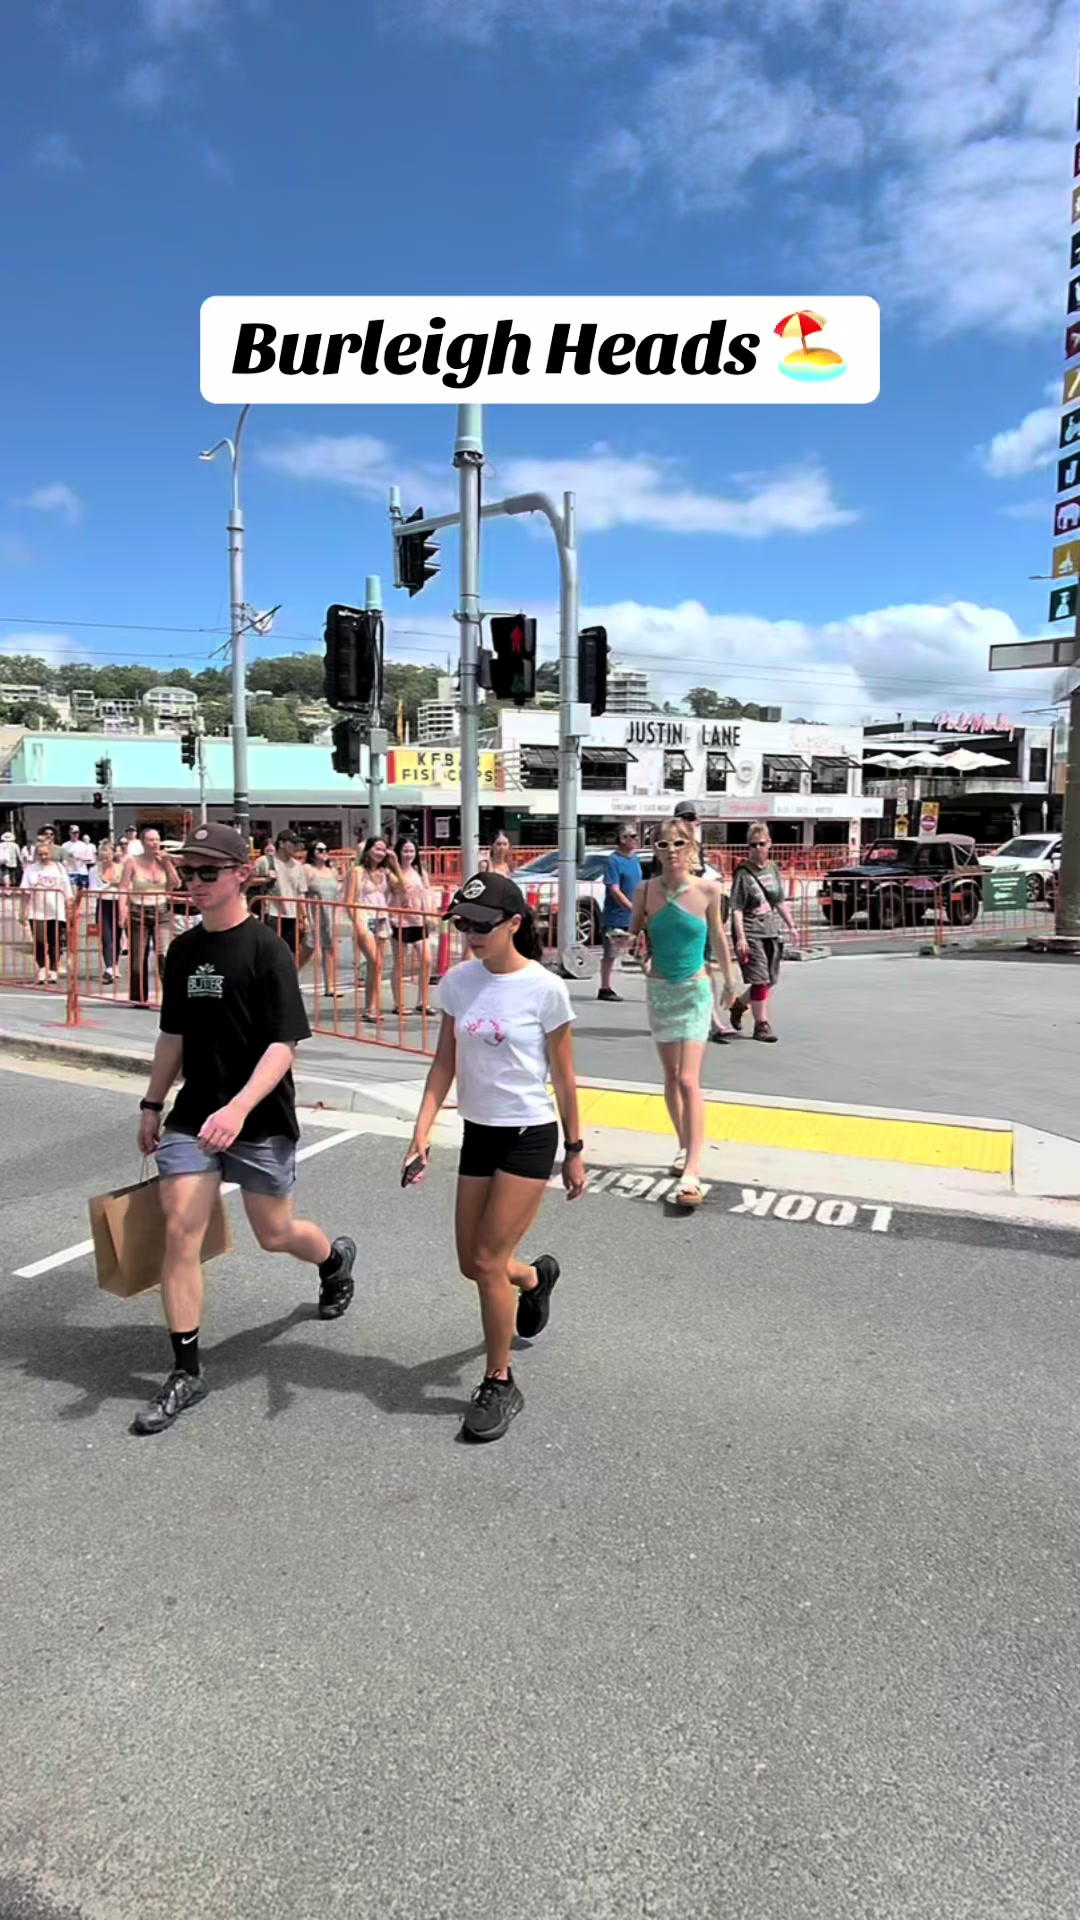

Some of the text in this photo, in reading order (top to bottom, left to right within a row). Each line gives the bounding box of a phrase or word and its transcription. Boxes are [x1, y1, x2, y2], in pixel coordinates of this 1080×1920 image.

[626, 720, 741, 747] JUSTIN LANE
[728, 1187, 895, 1232] LOOK
